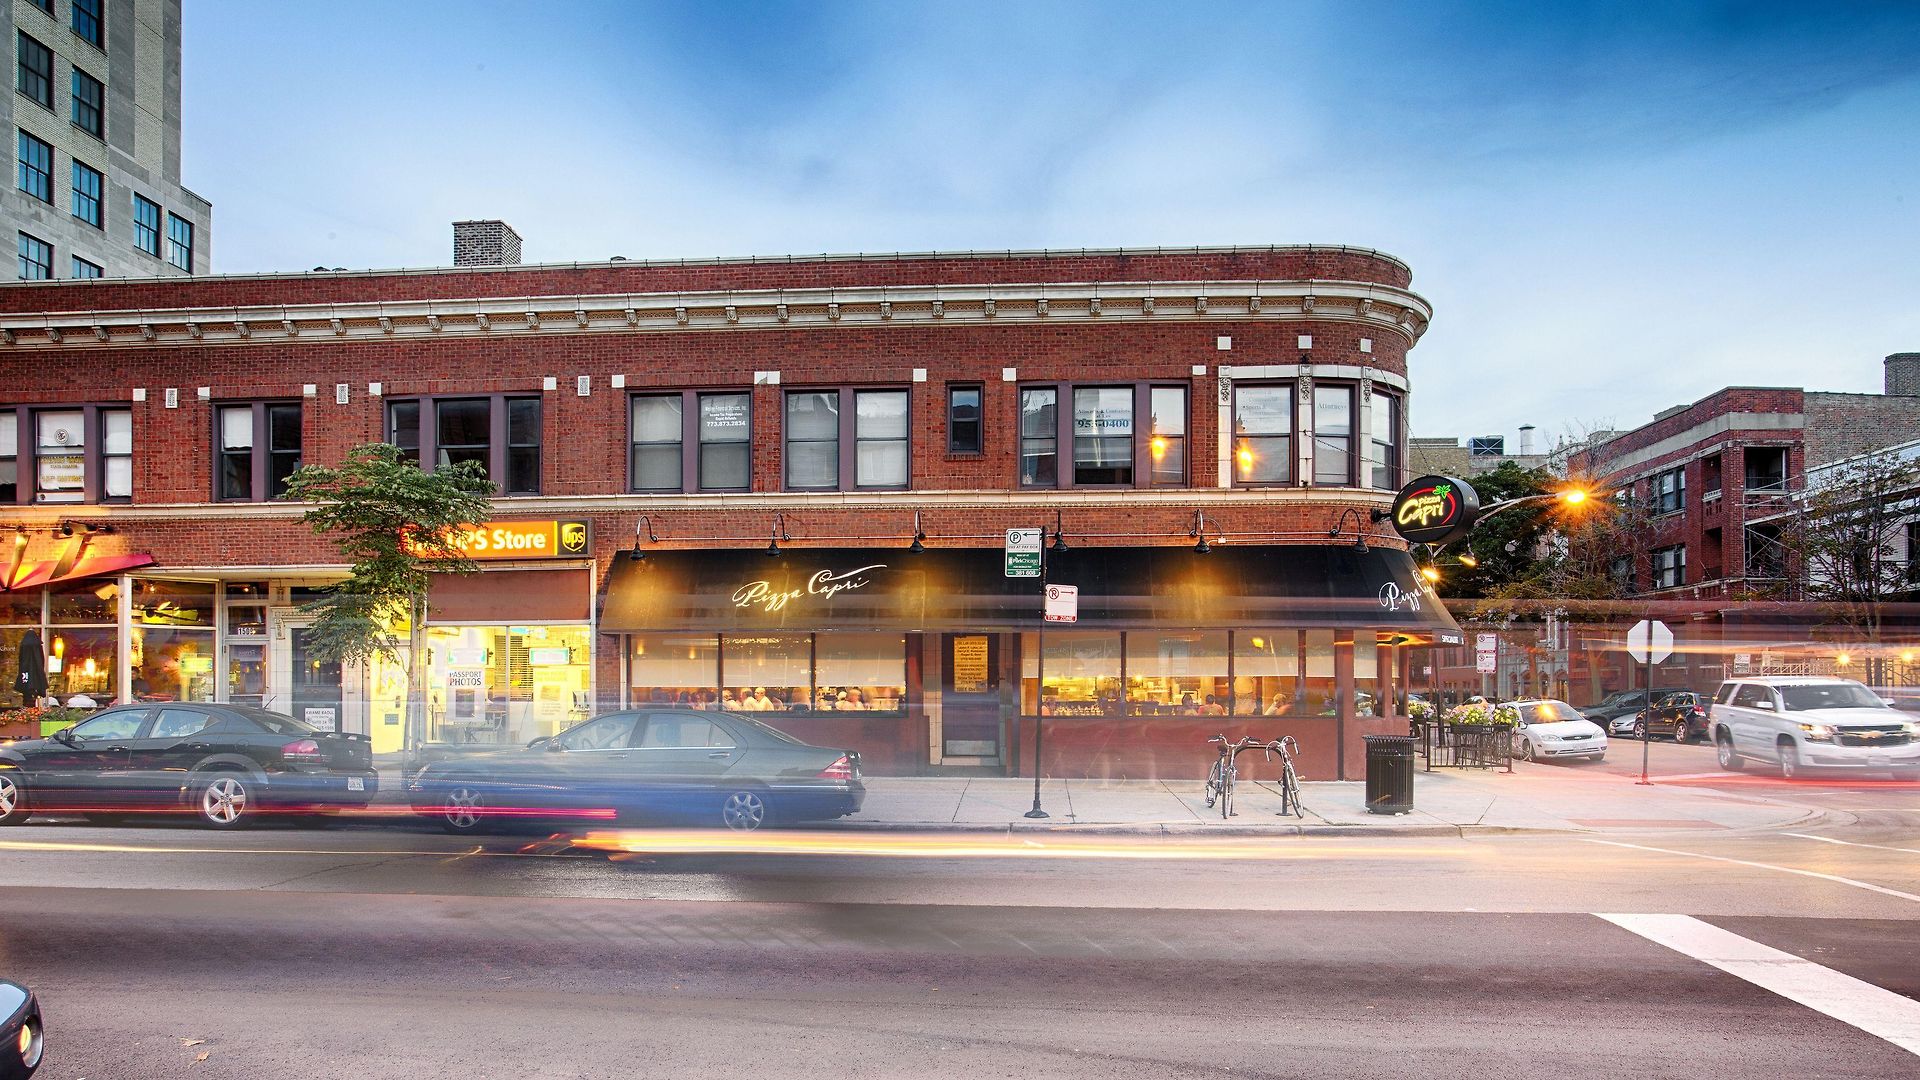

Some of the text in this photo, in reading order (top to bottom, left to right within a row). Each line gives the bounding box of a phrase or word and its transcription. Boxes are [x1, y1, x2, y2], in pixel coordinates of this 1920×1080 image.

[1398, 498, 1445, 526] Capri
[493, 529, 545, 550] Store
[564, 531, 584, 547] ups
[732, 564, 888, 612] Pizza Capri
[1379, 581, 1423, 612] Pizza
[449, 670, 482, 678] PASSPORT
[449, 678, 482, 686] PHOTOS
